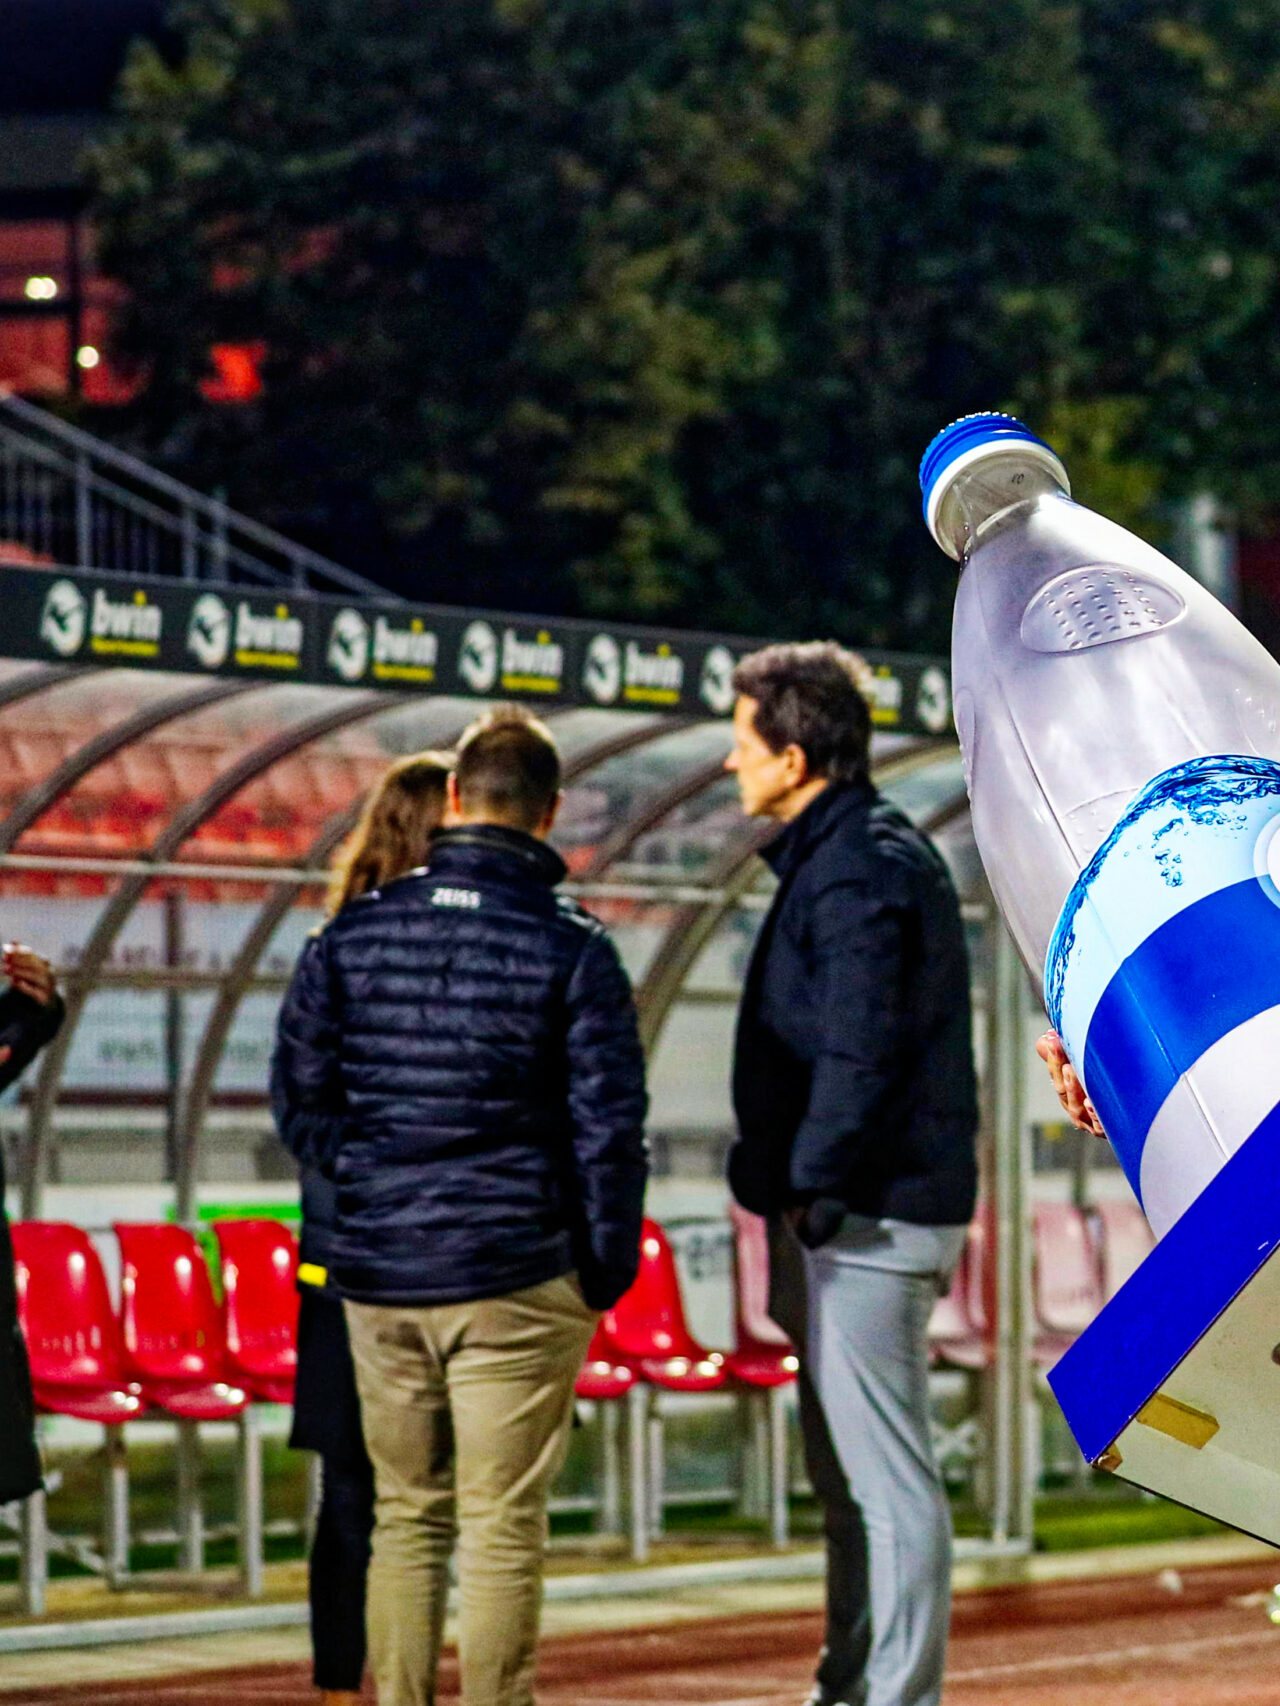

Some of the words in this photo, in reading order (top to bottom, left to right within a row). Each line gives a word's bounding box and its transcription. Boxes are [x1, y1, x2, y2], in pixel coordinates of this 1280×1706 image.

[92, 589, 162, 640] bwin
[235, 602, 302, 652] bwin
[374, 616, 438, 665] bwin
[502, 629, 563, 678] bwin
[625, 641, 684, 688] bwin
